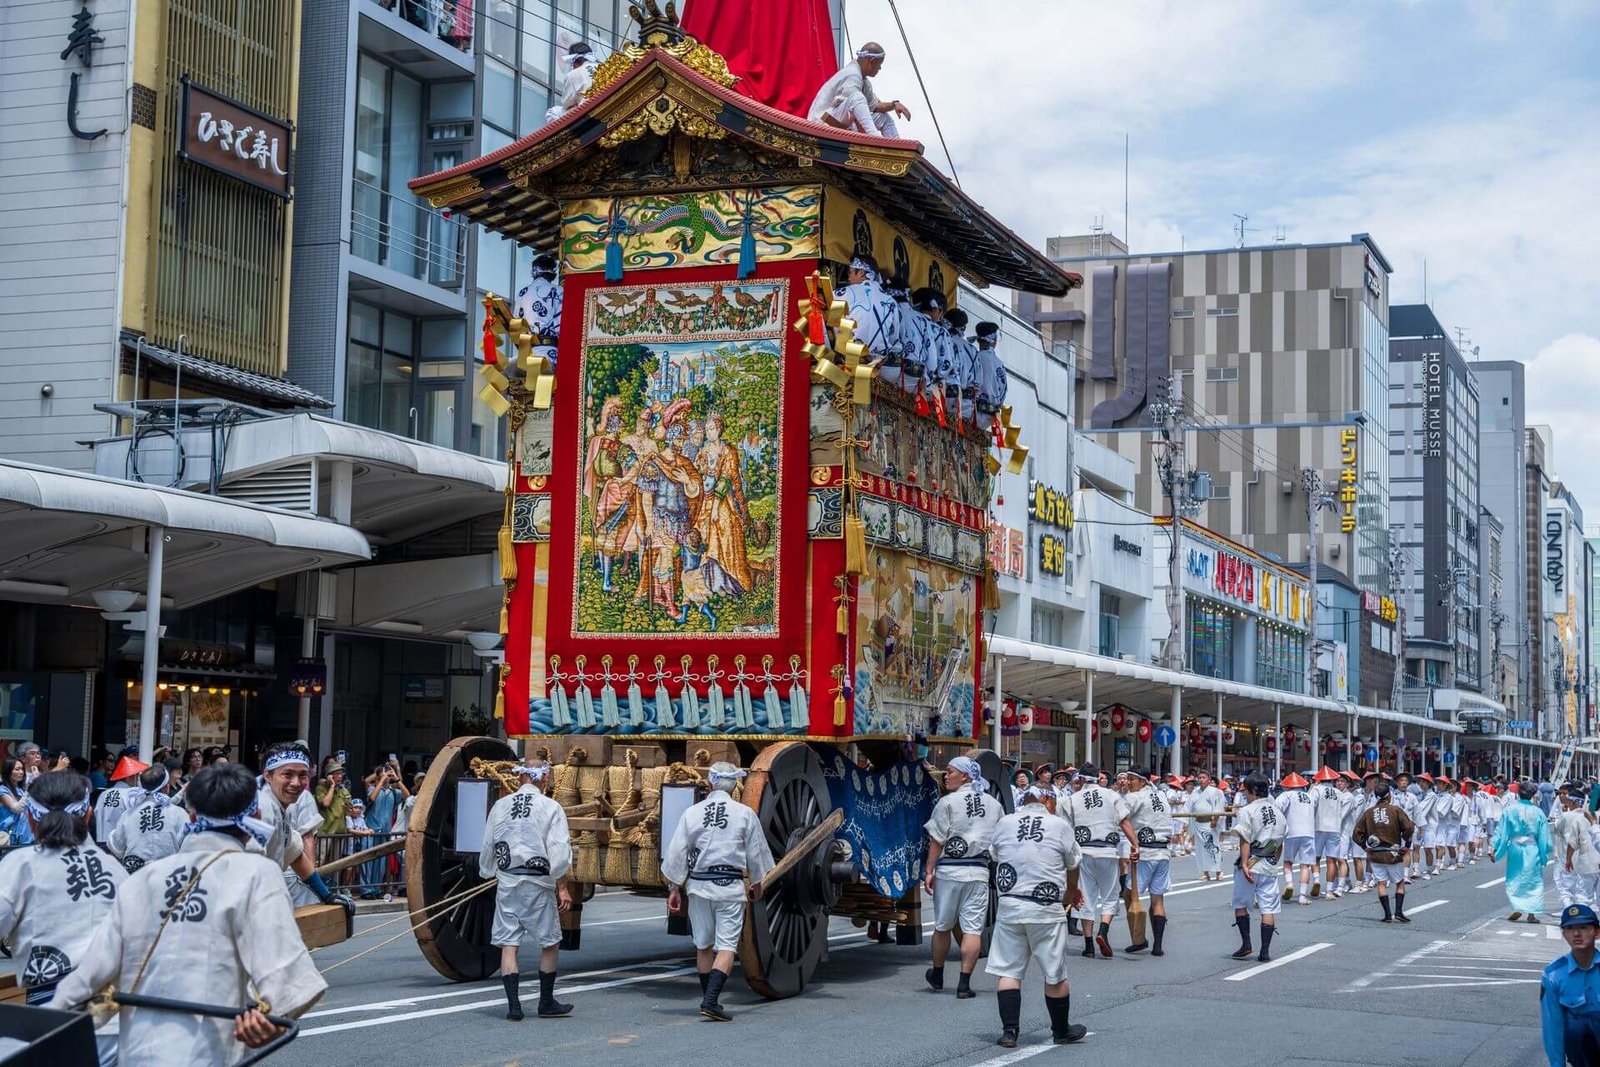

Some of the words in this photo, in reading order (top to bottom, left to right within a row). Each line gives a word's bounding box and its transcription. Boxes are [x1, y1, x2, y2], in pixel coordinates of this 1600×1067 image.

[1429, 352, 1440, 402] HOTEL
[1429, 409, 1440, 457] MUSSE
[1341, 429, 1356, 533] ドンキホーテ
[1034, 481, 1074, 532] 処方せん
[1042, 534, 1065, 577] 受付
[1188, 548, 1209, 579] SLOT
